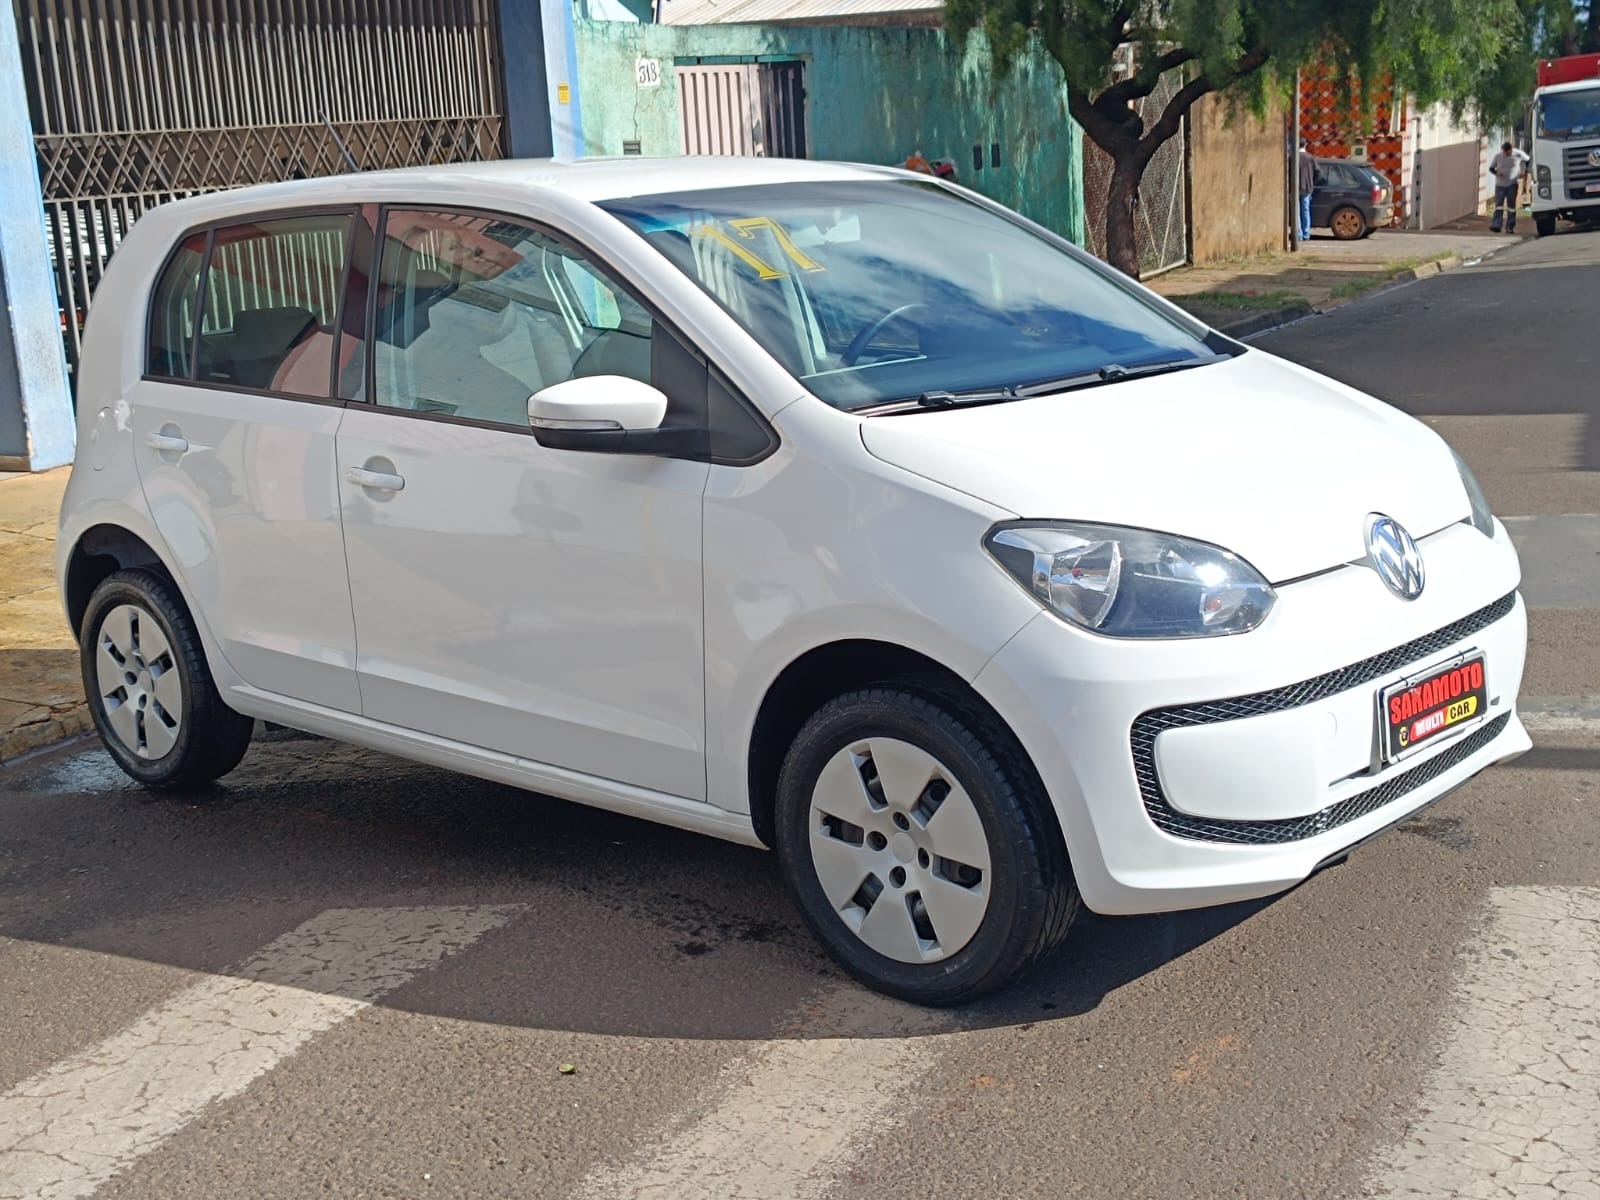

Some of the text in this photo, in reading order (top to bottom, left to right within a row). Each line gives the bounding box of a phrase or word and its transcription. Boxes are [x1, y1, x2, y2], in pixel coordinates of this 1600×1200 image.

[639, 62, 657, 84] 318
[690, 217, 826, 279] 17
[1390, 662, 1483, 724] SAKAMOTO
[1415, 701, 1470, 737] MULTI CAR
